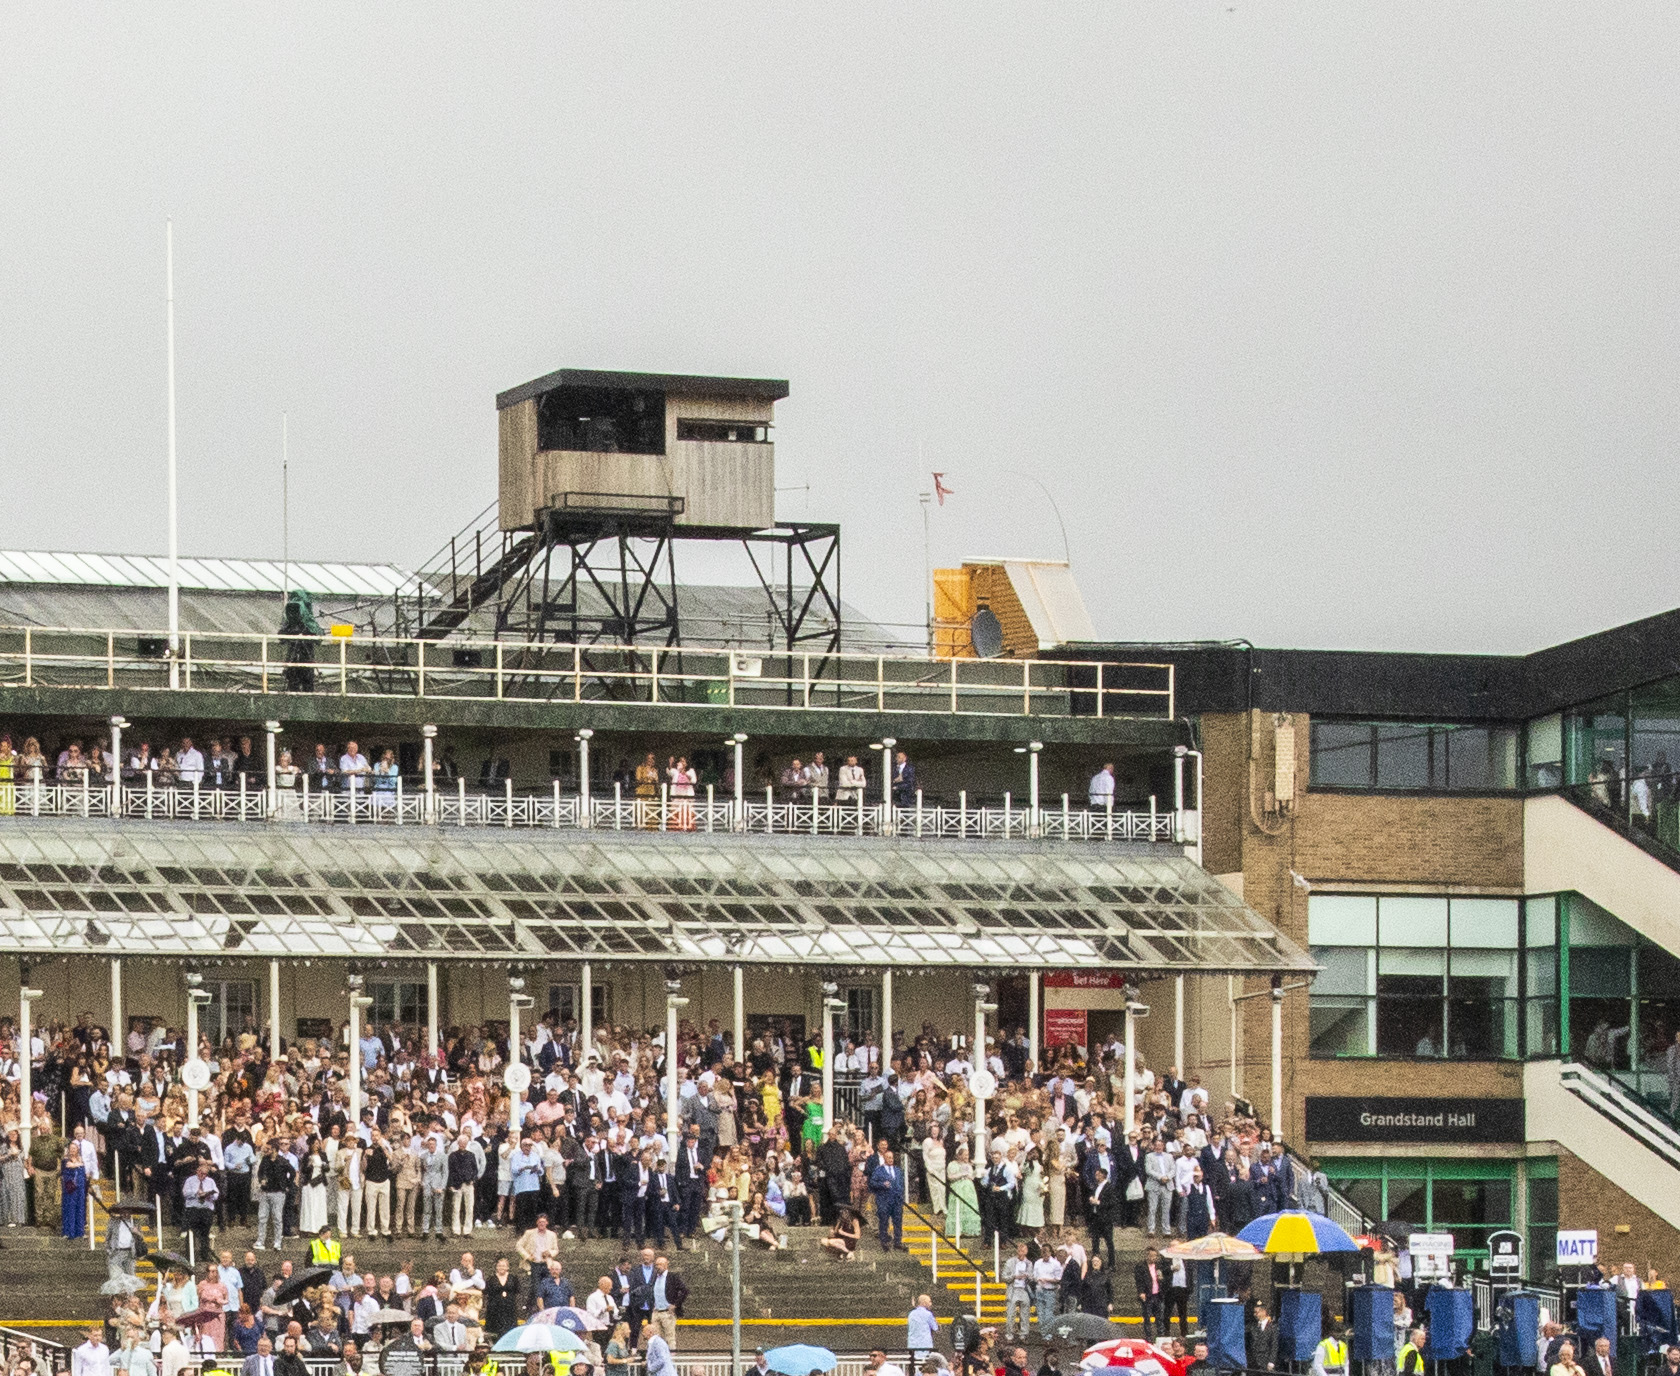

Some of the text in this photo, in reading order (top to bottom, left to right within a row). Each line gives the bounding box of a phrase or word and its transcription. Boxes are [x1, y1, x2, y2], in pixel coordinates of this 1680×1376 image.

[1360, 1112, 1476, 1127] Grandstand Hall
[1558, 1239, 1596, 1256] MATT
